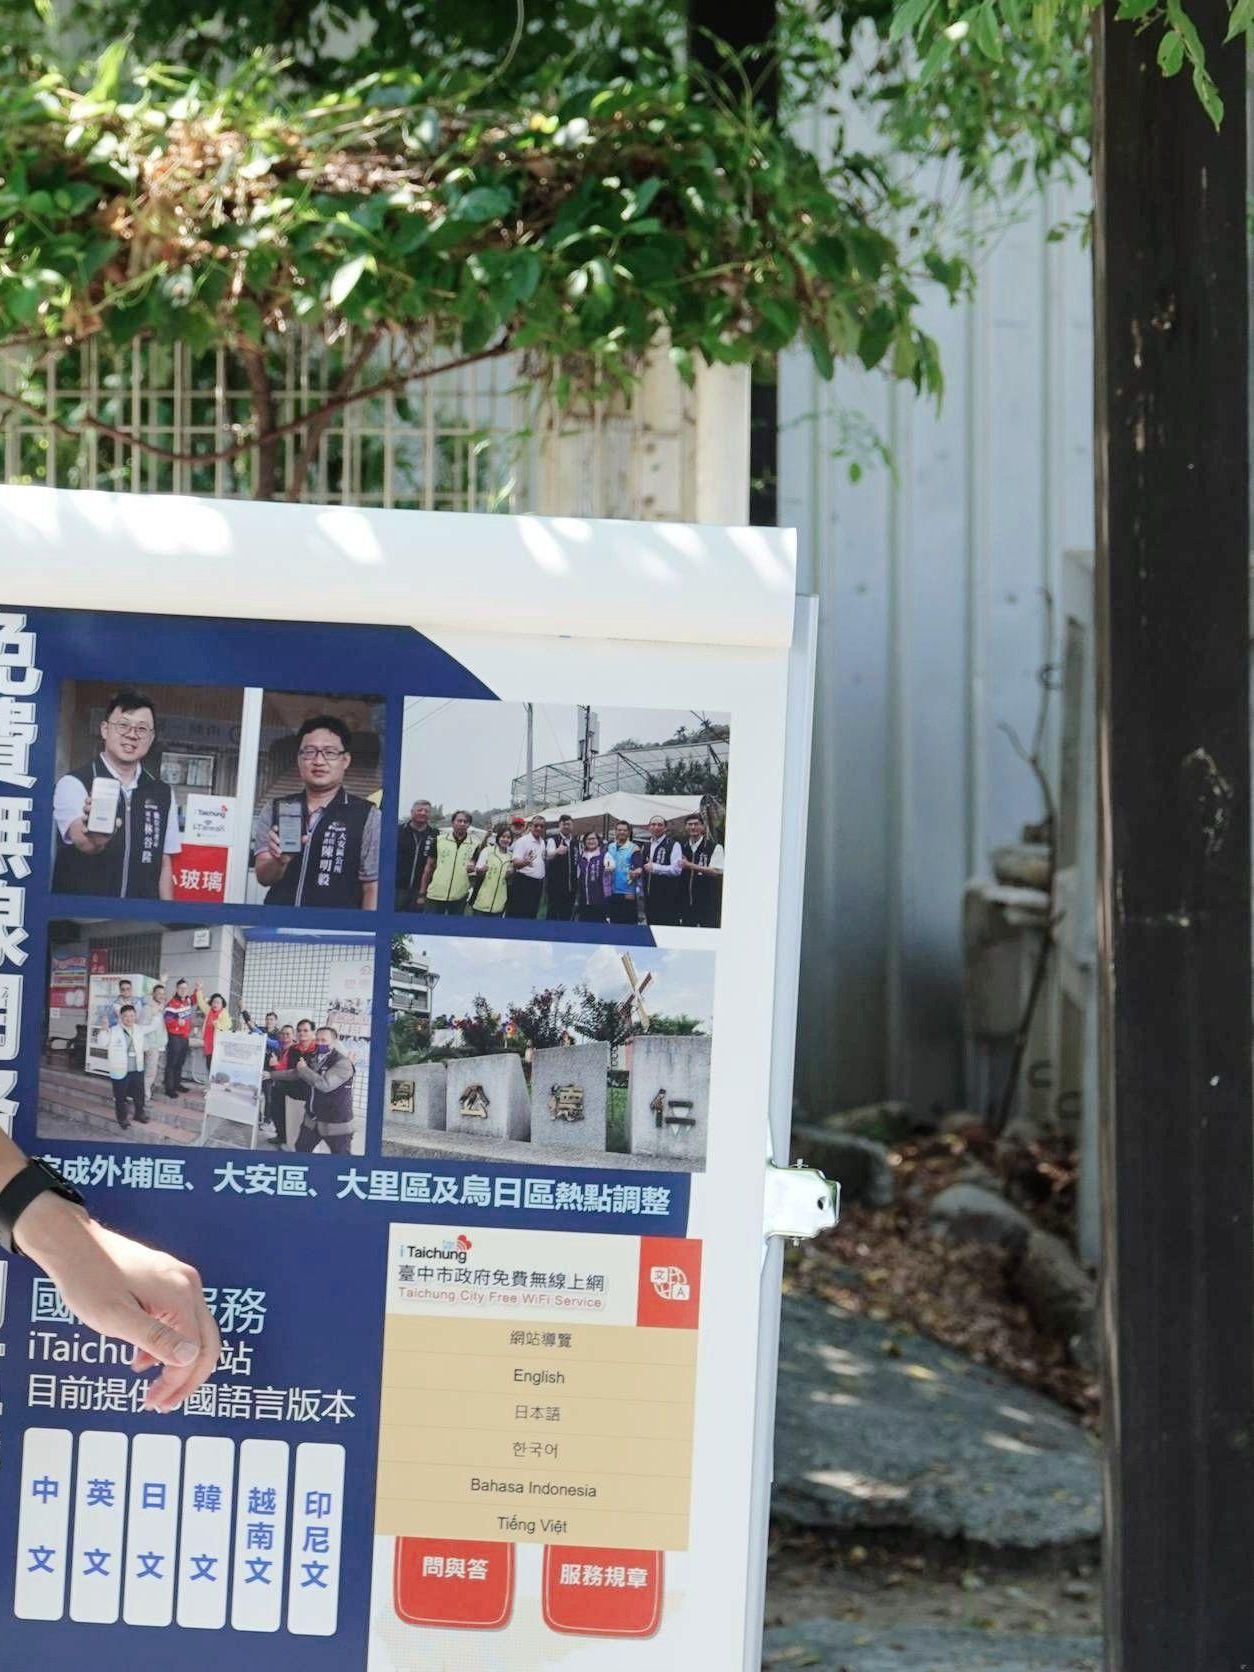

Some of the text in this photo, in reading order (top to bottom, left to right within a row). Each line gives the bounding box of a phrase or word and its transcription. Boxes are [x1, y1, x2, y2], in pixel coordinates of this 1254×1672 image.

[172, 868, 224, 893] 玻璃
[398, 1264, 605, 1292] 臺中市政府免費無線上網
[399, 1285, 602, 1308] Taichung City Free WiFi Service
[509, 1329, 573, 1349] 網站導覽
[513, 1368, 566, 1385] English
[28, 1373, 357, 1425] 目前提供國語言版本
[514, 1405, 562, 1422] 日本語
[512, 1441, 559, 1459] 한국어
[469, 1478, 598, 1498] Bahasa Indonesia
[244, 1486, 278, 1586] 越南文
[497, 1514, 568, 1534] Tiếng Việt
[300, 1490, 333, 1589] 印尼文
[422, 1555, 490, 1581] 問與答
[559, 1563, 649, 1589] 服務規章
